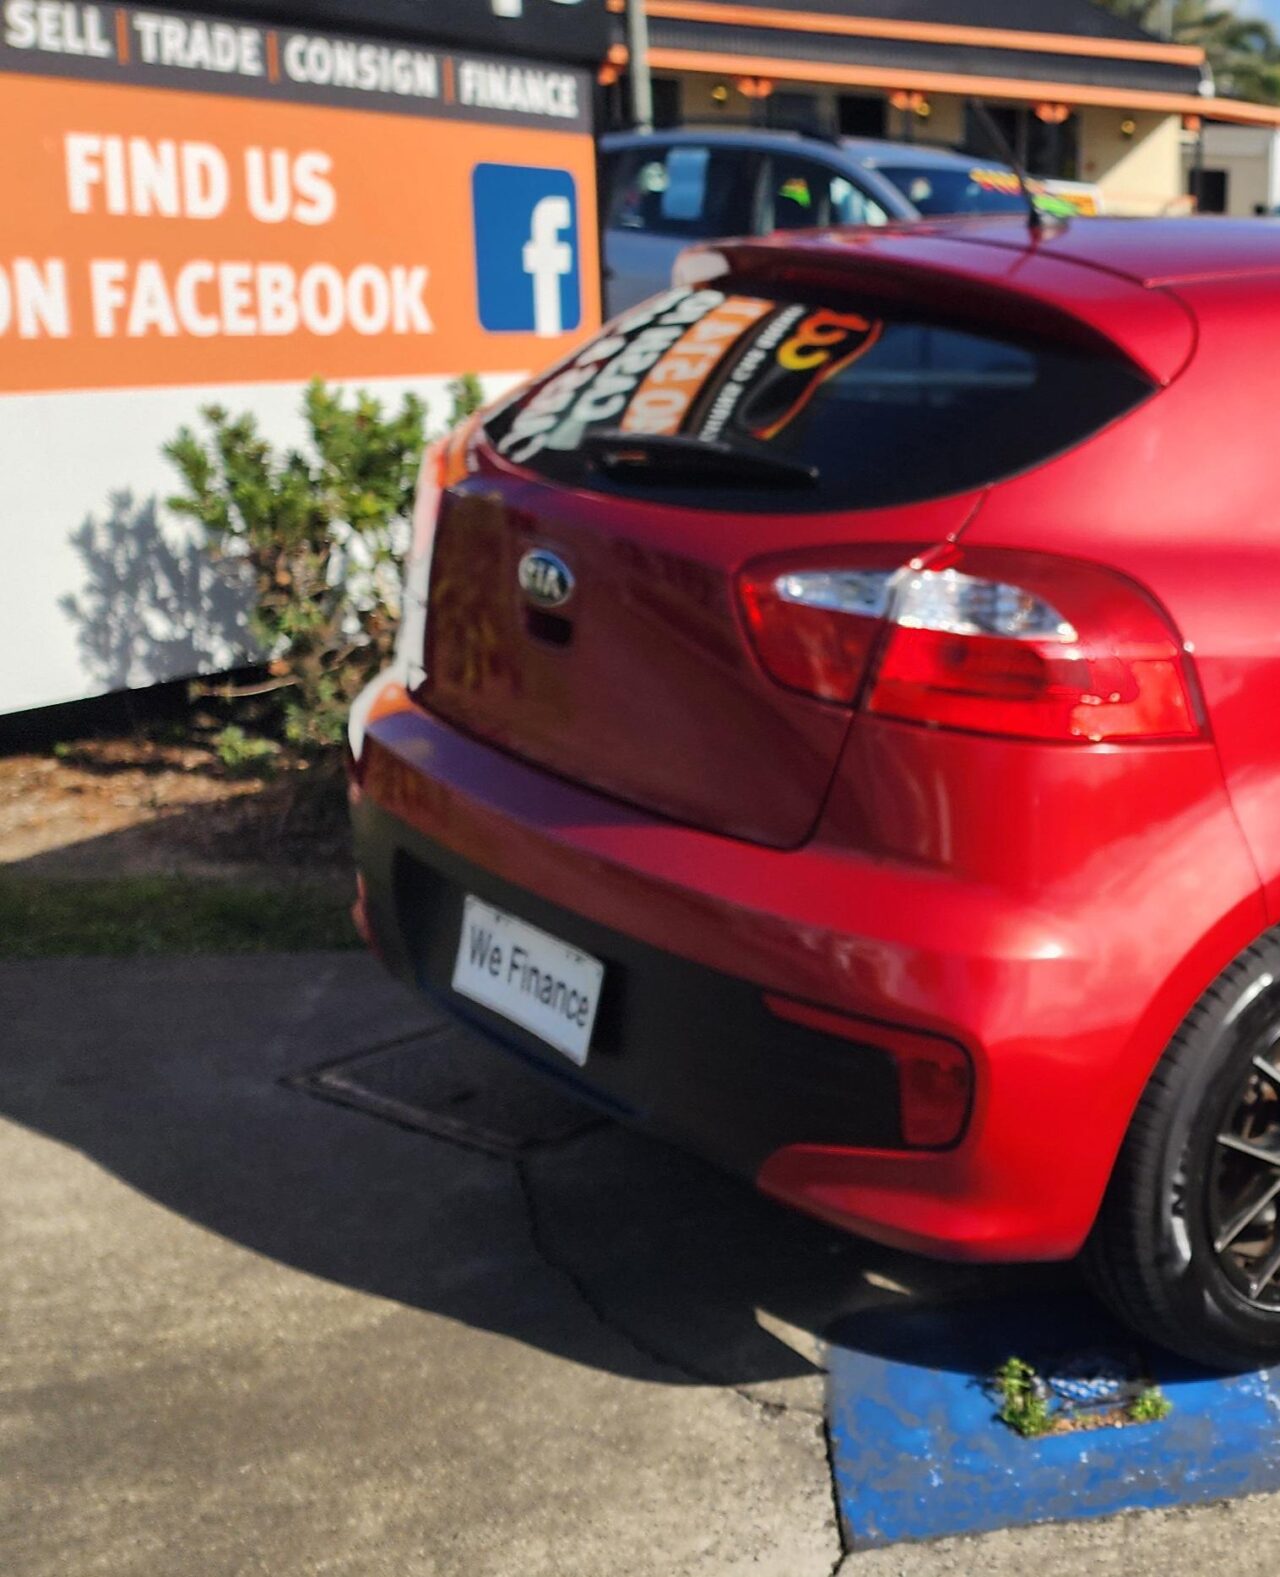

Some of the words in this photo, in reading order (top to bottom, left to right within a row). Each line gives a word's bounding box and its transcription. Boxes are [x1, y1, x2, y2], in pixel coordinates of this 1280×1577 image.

[3, 0, 112, 58] SELL
[132, 12, 265, 76] TRADE
[284, 34, 439, 98] CONSIGN
[459, 60, 579, 119] FINANCE
[65, 133, 230, 219] FIND
[245, 146, 336, 225] US
[90, 259, 433, 337] FACEBOOK
[525, 558, 566, 602] KIA
[467, 925, 502, 977] We
[507, 945, 590, 1027] Finance
